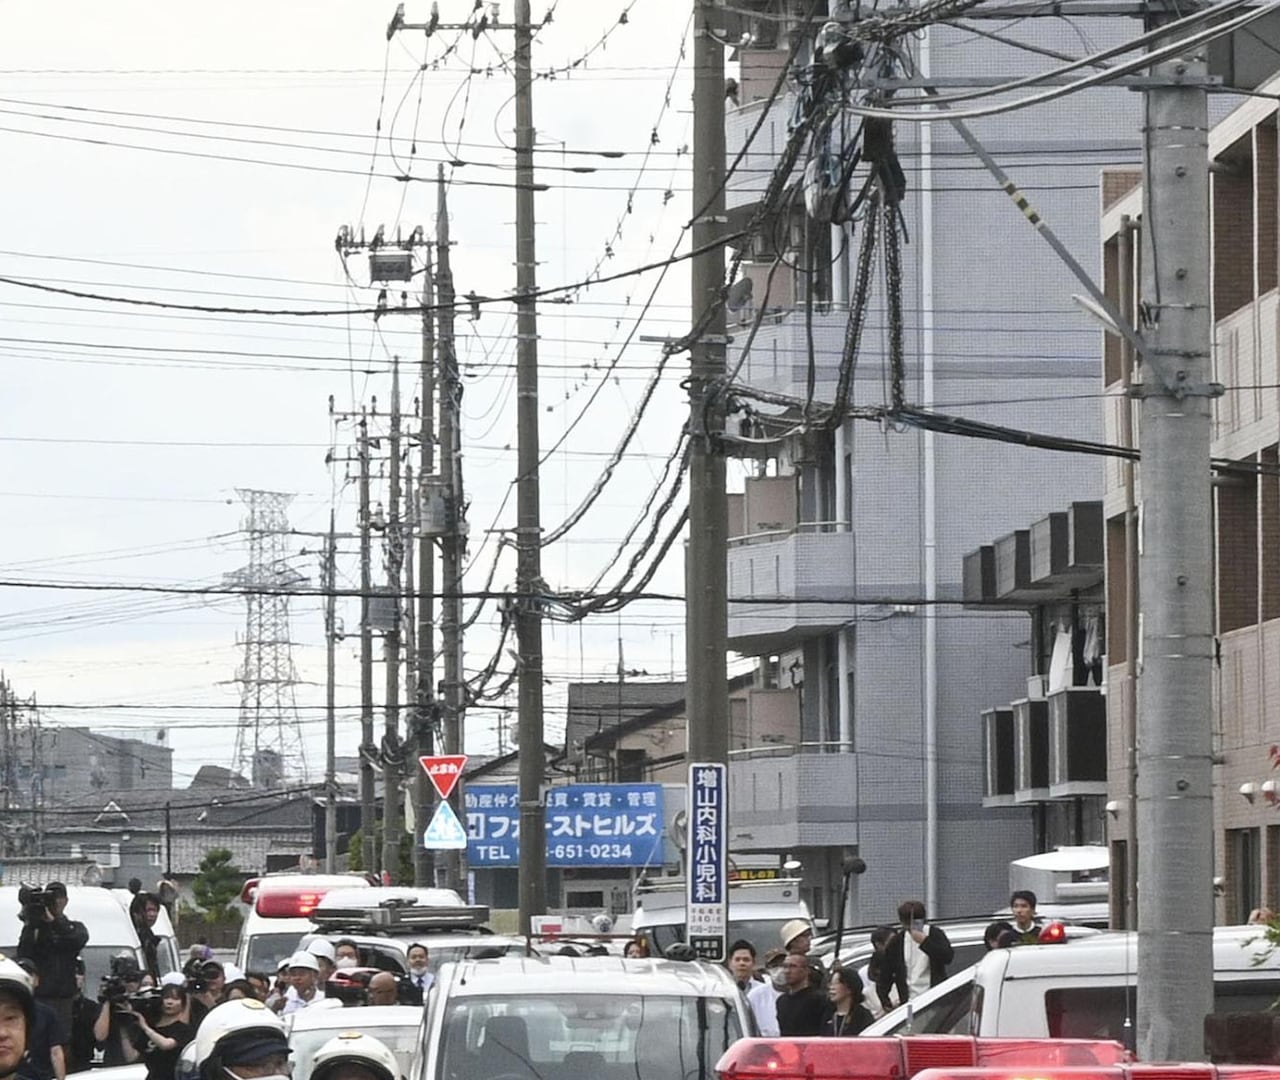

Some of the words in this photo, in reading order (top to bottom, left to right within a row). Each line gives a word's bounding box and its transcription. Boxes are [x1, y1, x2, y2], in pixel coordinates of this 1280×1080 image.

[476, 846, 510, 859] TEL
[517, 844, 632, 859] -651-0234
[696, 769, 718, 902] 増山内科小児科
